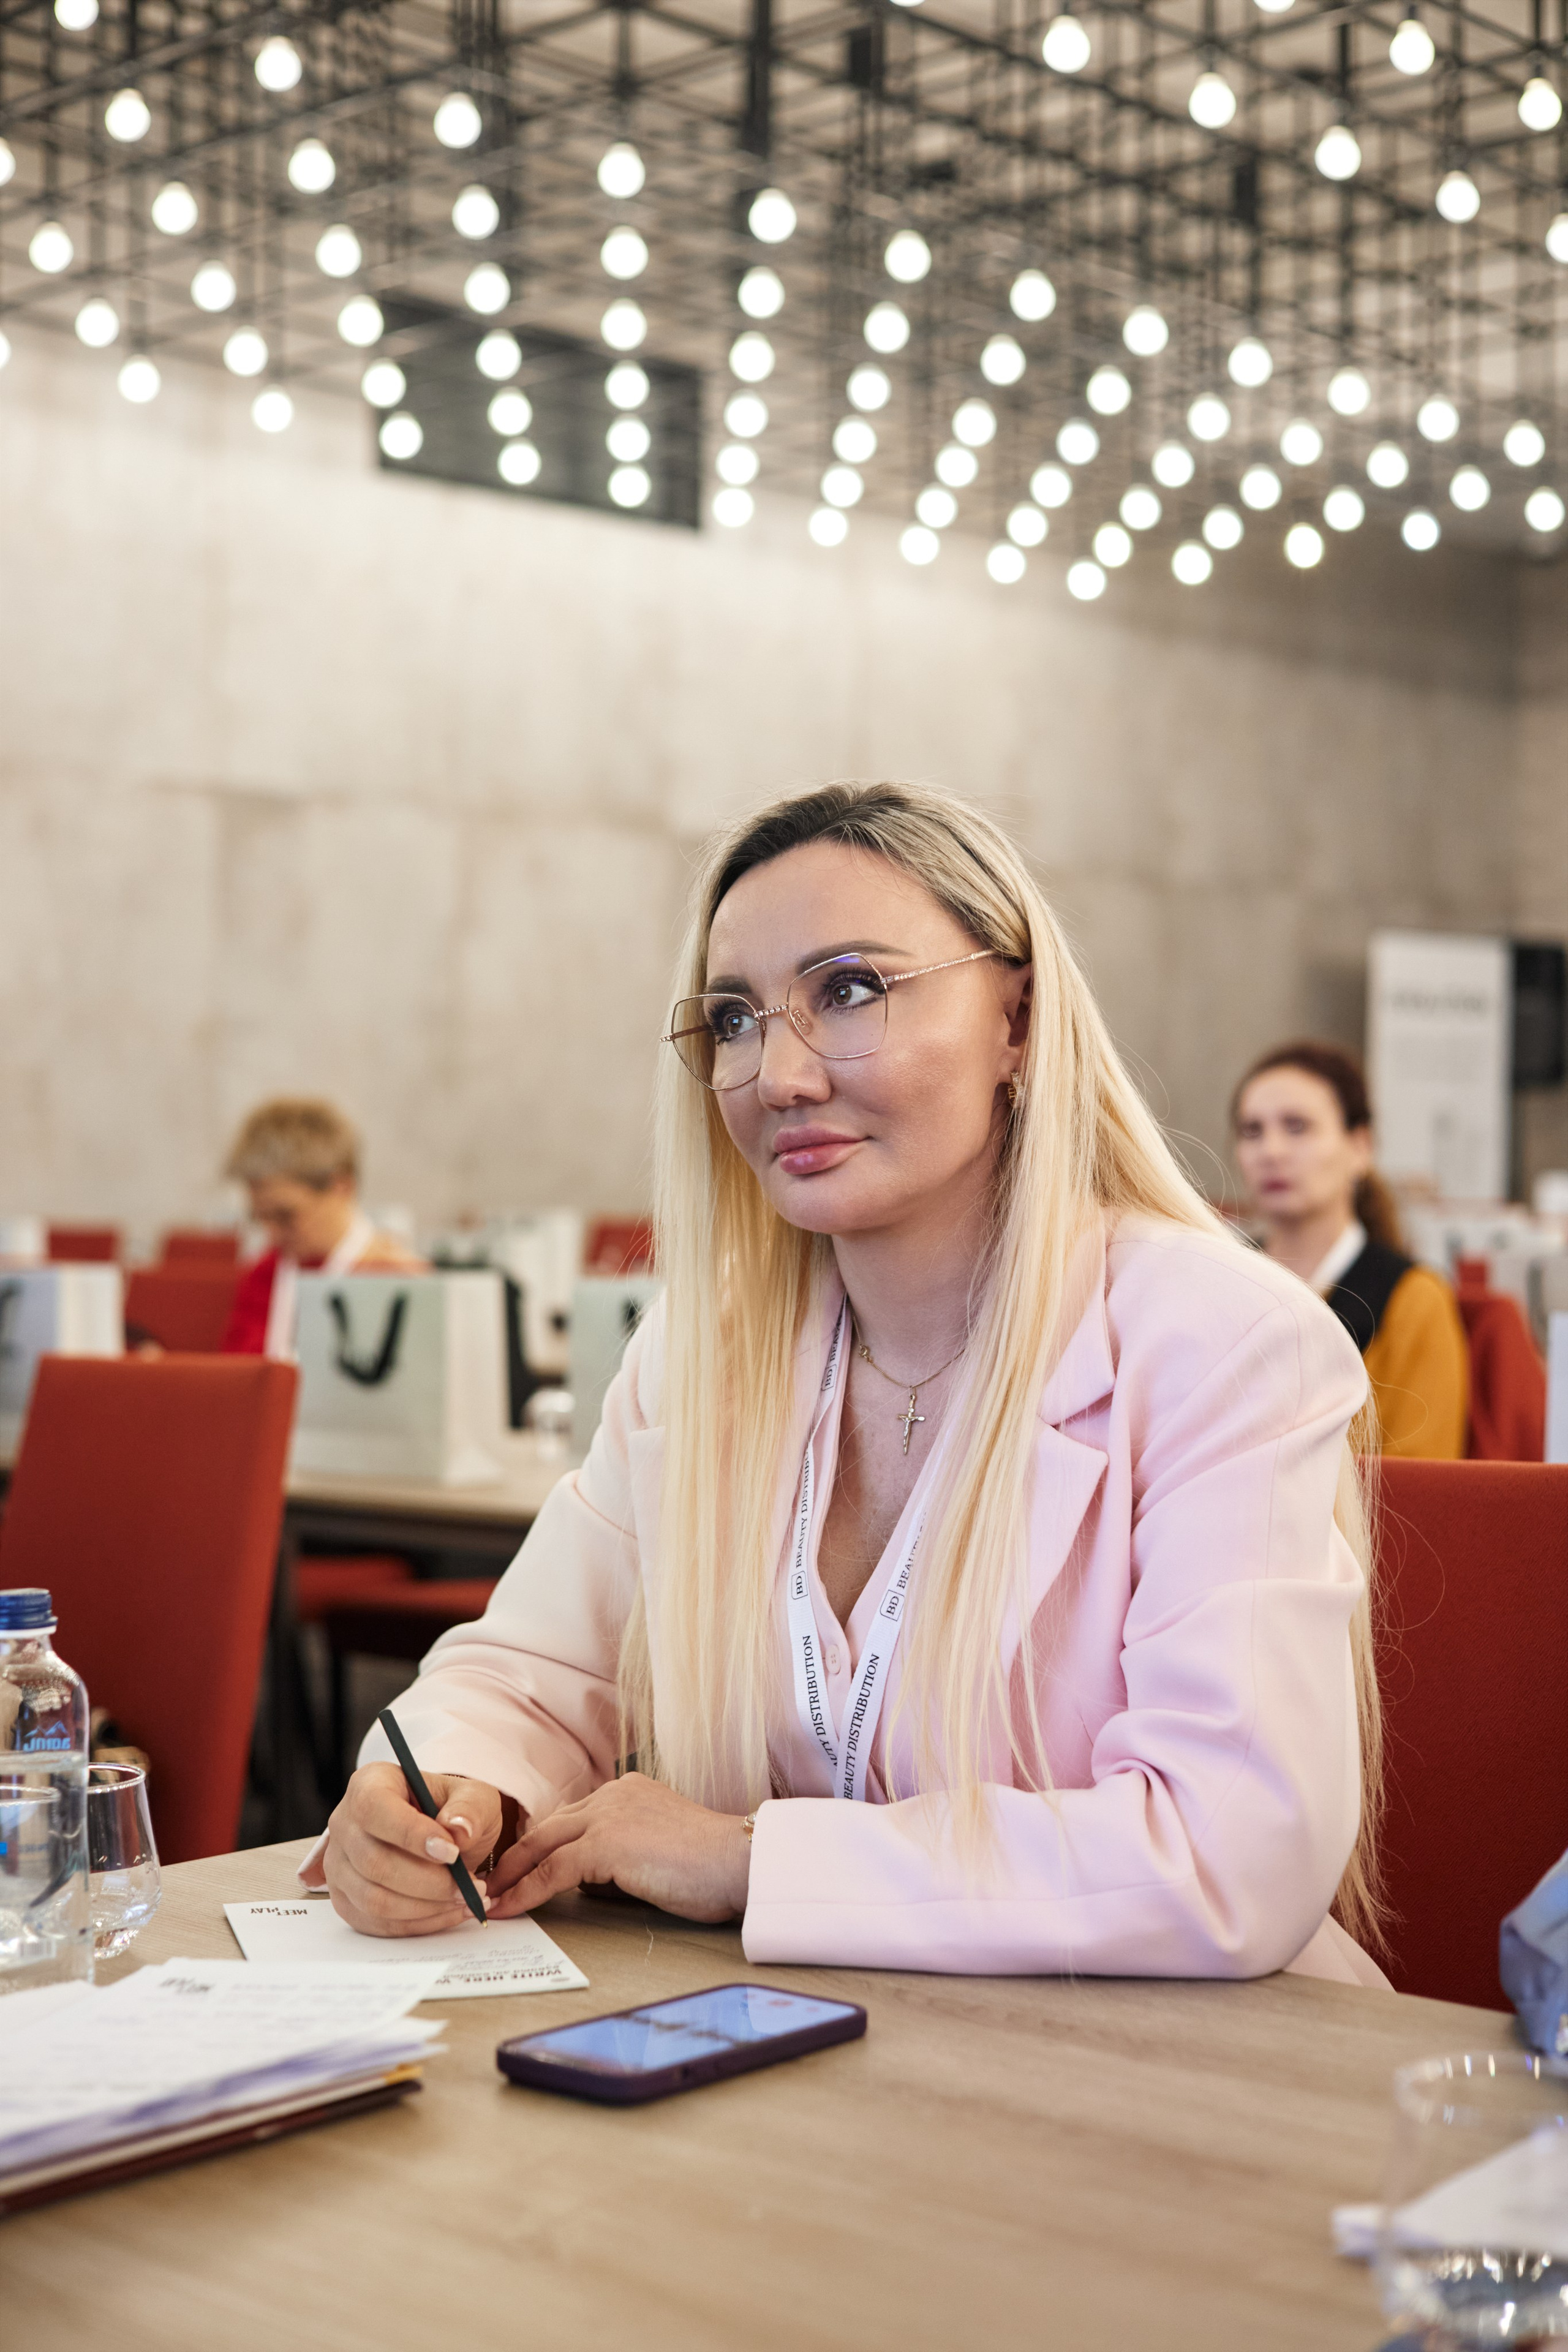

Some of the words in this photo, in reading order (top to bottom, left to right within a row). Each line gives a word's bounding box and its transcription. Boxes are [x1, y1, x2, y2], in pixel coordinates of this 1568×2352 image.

[824, 1368, 833, 1387] BD
[801, 1452, 810, 1514] DISTRIB
[796, 1518, 808, 1569] BEAUTY
[796, 1575, 804, 1595] BD
[886, 1596, 900, 1616] BD
[802, 1635, 826, 1737] DISTRIBUTION
[848, 1653, 880, 1752] DISTRIBUTION
[820, 1738, 839, 1768] AUTY
[843, 1753, 856, 1801] BEAUTY
